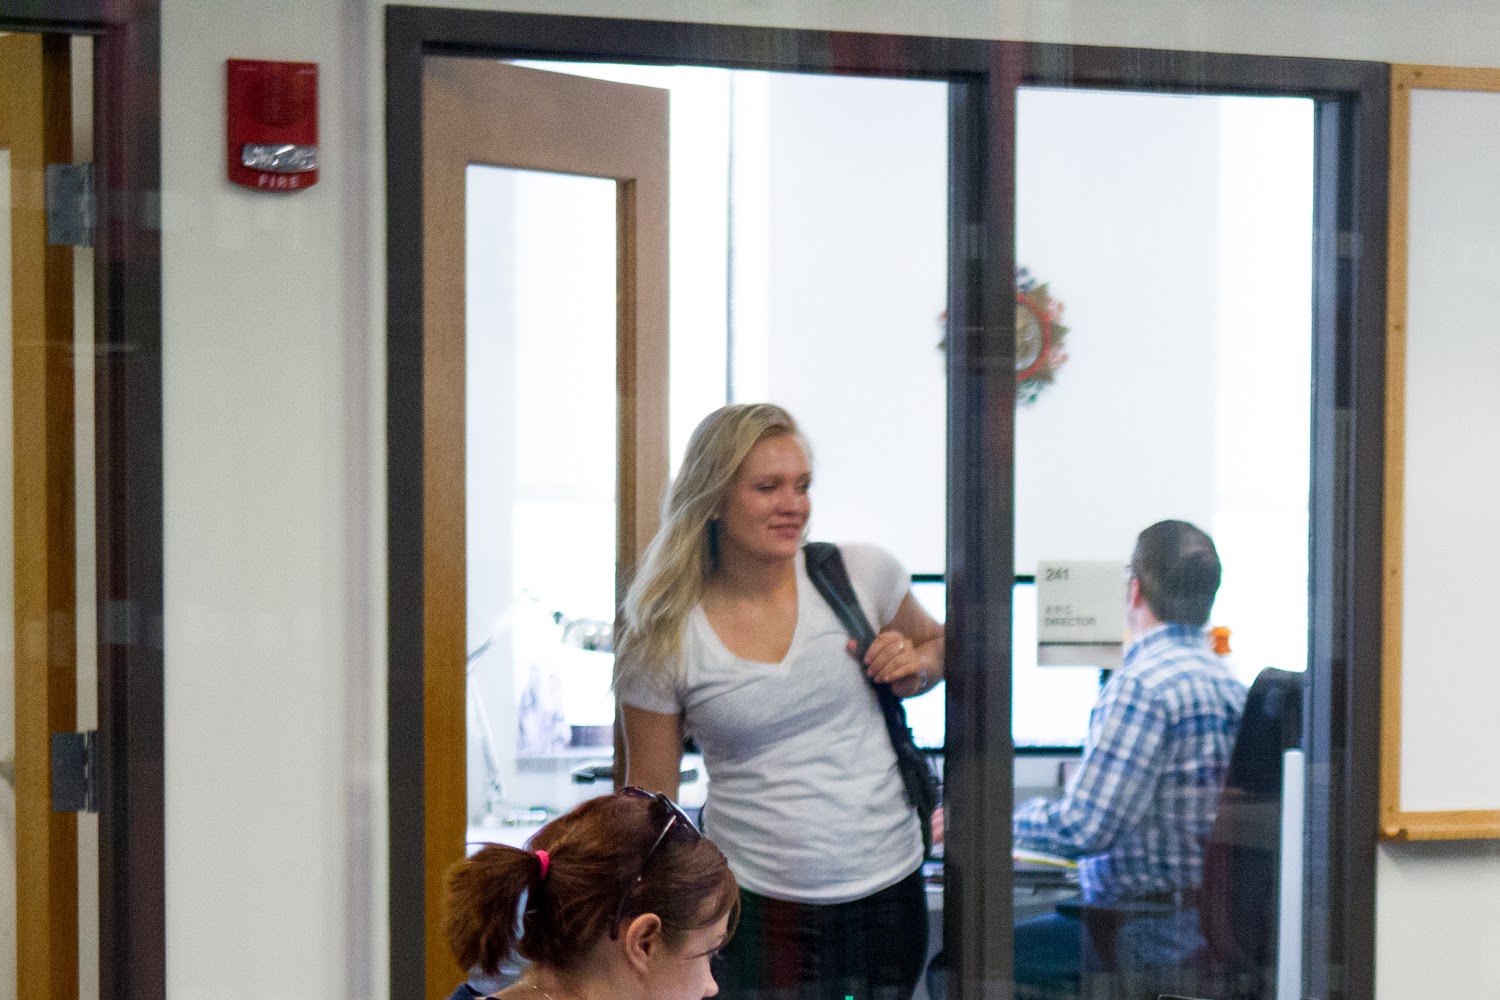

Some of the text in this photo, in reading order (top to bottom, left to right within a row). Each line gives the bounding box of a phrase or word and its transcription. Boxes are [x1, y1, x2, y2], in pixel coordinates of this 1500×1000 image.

[258, 174, 300, 188] FIRE
[1046, 567, 1069, 581] 241
[1045, 617, 1096, 627] DIRECTOR
